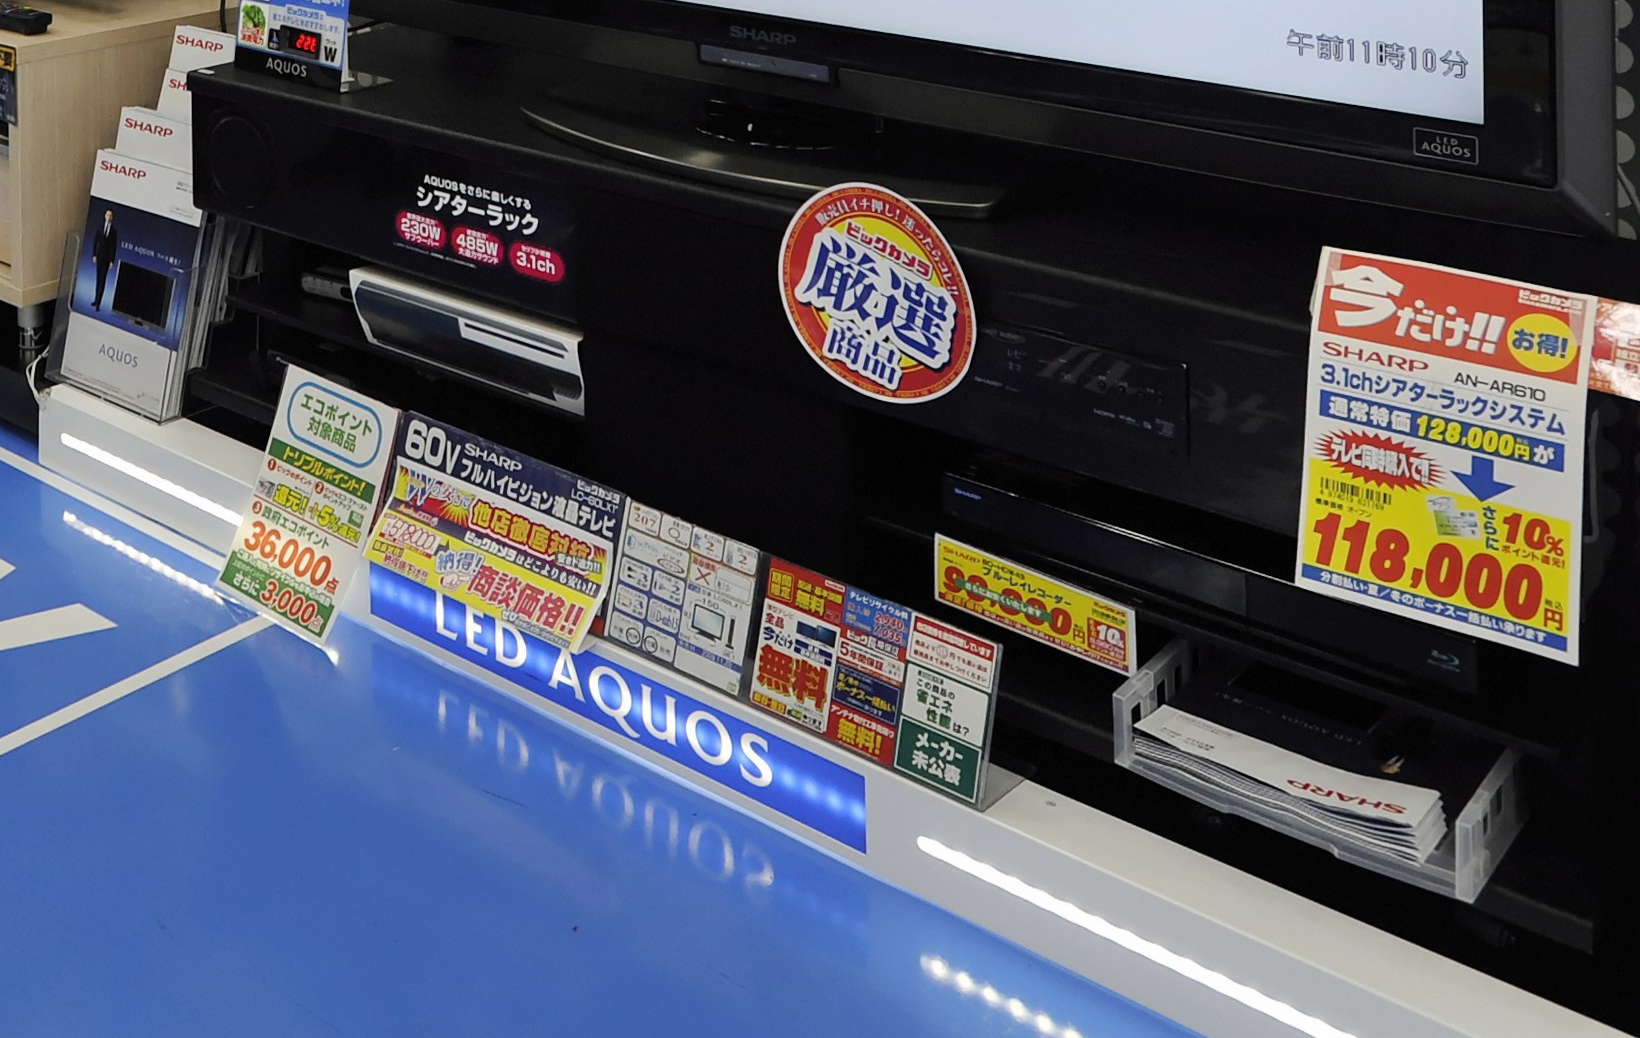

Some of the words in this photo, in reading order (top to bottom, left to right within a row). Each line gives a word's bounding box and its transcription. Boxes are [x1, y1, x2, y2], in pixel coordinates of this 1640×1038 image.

[176, 34, 224, 53] SHARP
[729, 25, 797, 45] SHARP
[1286, 28, 1469, 79] 午前11時10分
[266, 57, 307, 78] AQUOS
[324, 45, 338, 63] W
[124, 117, 173, 139] SHARP
[1421, 141, 1471, 158] AQUOS
[100, 159, 147, 181] SHARP
[416, 185, 539, 236] シアターラック
[423, 173, 533, 211] AQUOSをさらに楽しくする
[400, 216, 441, 241] 230W
[455, 234, 499, 258] 485W
[516, 251, 556, 275] 3.1ch
[846, 221, 933, 279] ビックカメラ
[802, 234, 949, 360] 厳選
[1329, 264, 1506, 356] 今だけ!!
[98, 342, 139, 368] AQUOS
[827, 325, 897, 386] 商品
[1322, 340, 1429, 372] SHARP
[1511, 328, 1569, 359] お得!
[1320, 363, 1566, 436] 3.1chシアターラックシステム
[1454, 372, 1547, 402] AN-AR610
[300, 393, 373, 437] エコポイント
[1329, 395, 1412, 432] 通常特価
[307, 416, 358, 453] 対象商品
[283, 445, 367, 496] トリプルポイント!
[464, 442, 523, 472] SHARP
[460, 458, 617, 538] フルハイビジョン液晶テレビ
[576, 479, 621, 504] ビックカメラ
[472, 500, 593, 558] 他店徹底対抗
[634, 511, 657, 528] 207
[1482, 504, 1500, 552] さらに
[1502, 511, 1566, 558] 10%
[1313, 511, 1543, 622] 118,000
[466, 564, 585, 638] 商談価格!!
[982, 566, 1073, 607] ブルーレイレコーダー
[763, 627, 794, 650] 今だけ
[765, 613, 785, 630] 全品
[1543, 608, 1564, 632] 円
[435, 592, 527, 670] LED
[548, 651, 774, 788] AQUOS
[756, 644, 828, 712] 無料
[917, 677, 956, 700] この商品の
[916, 688, 953, 713] 省エネ
[837, 718, 883, 756] 無料!
[916, 731, 964, 761] メーカー
[911, 750, 962, 787] 未公表
[1286, 778, 1408, 815] SHARP
